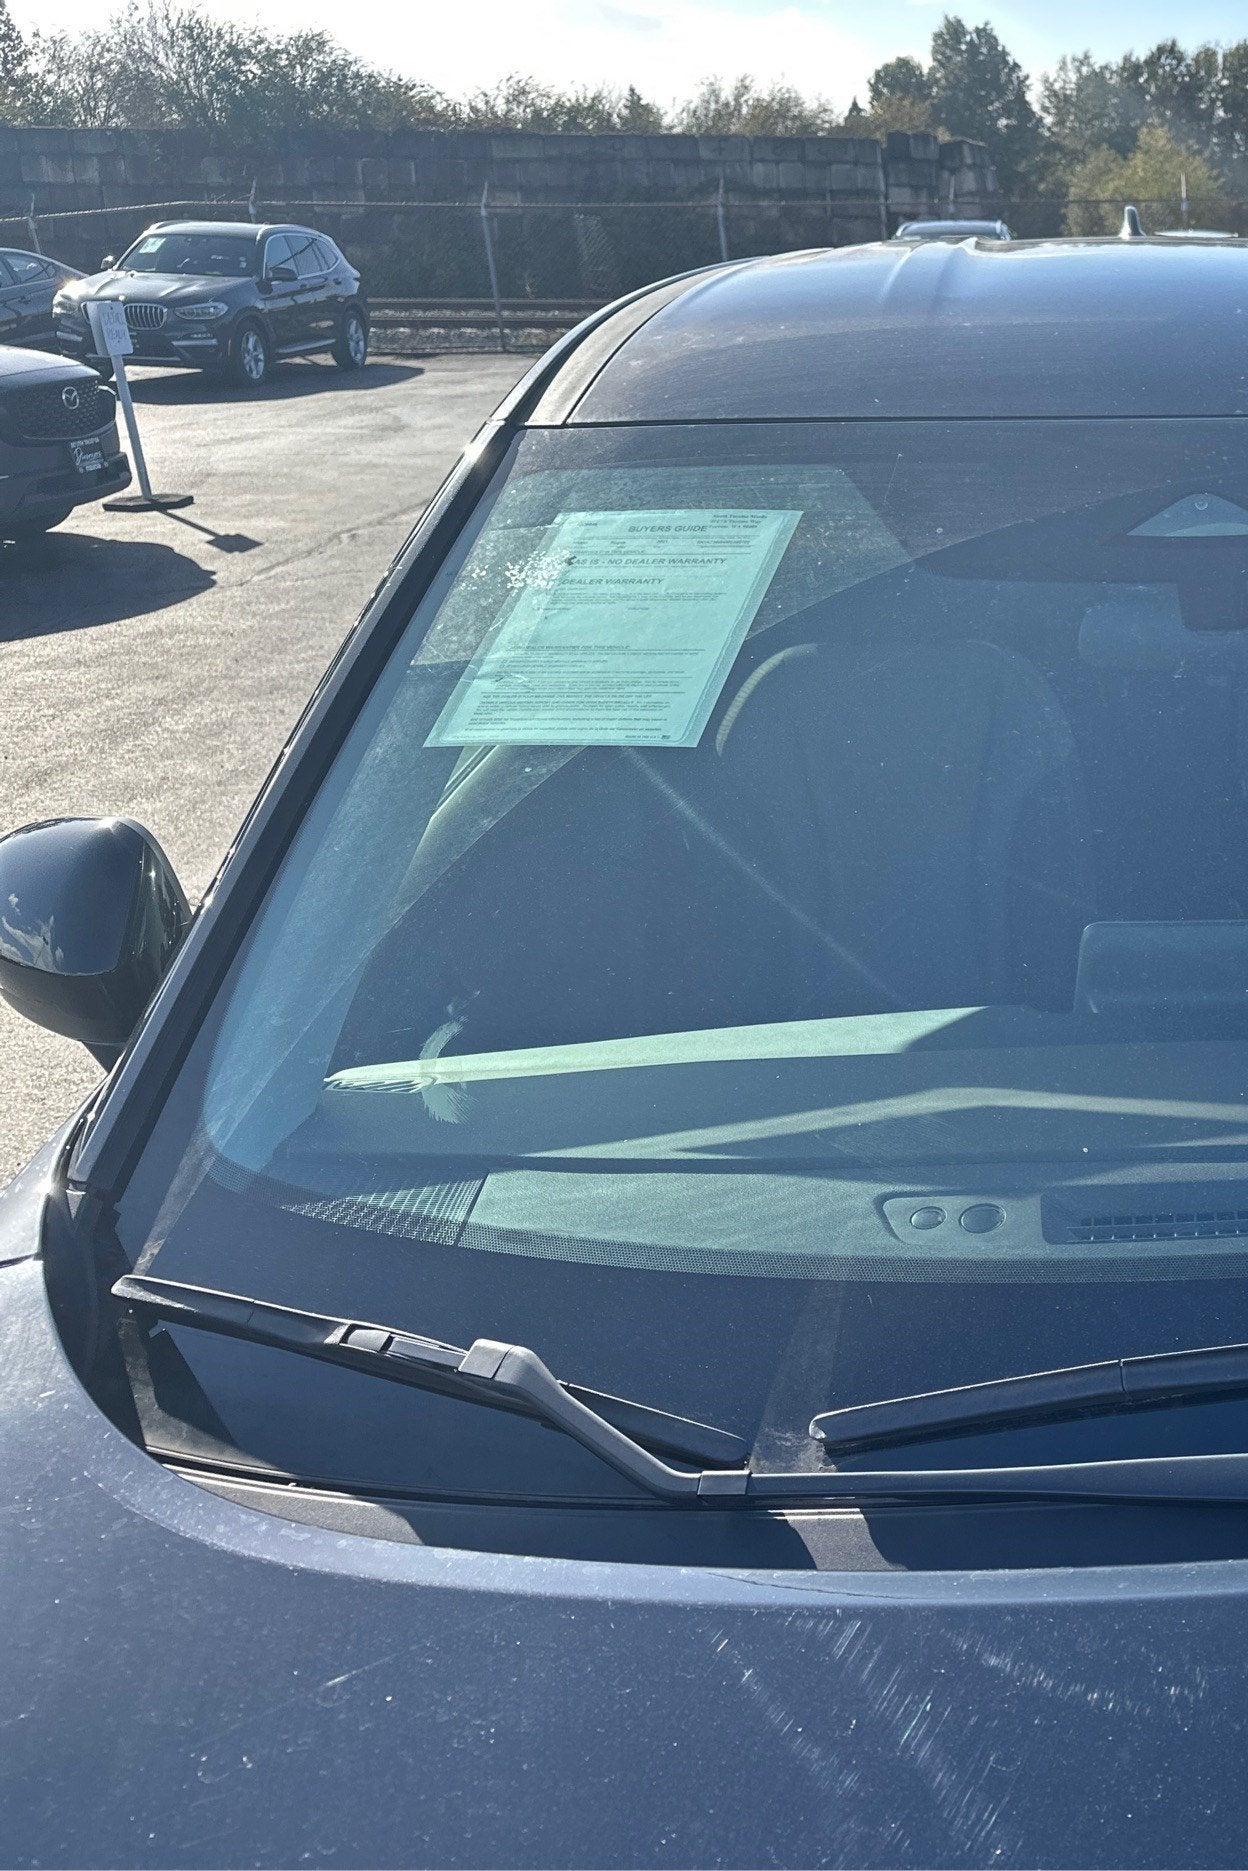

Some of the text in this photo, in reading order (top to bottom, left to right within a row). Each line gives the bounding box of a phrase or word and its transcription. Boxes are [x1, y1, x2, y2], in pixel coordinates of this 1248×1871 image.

[627, 525, 672, 533] BUYERS
[607, 558, 623, 566] NO
[624, 558, 666, 566] DEALER
[668, 557, 728, 565] WARRANTY
[561, 577, 665, 586] DEALER WARRANTY
